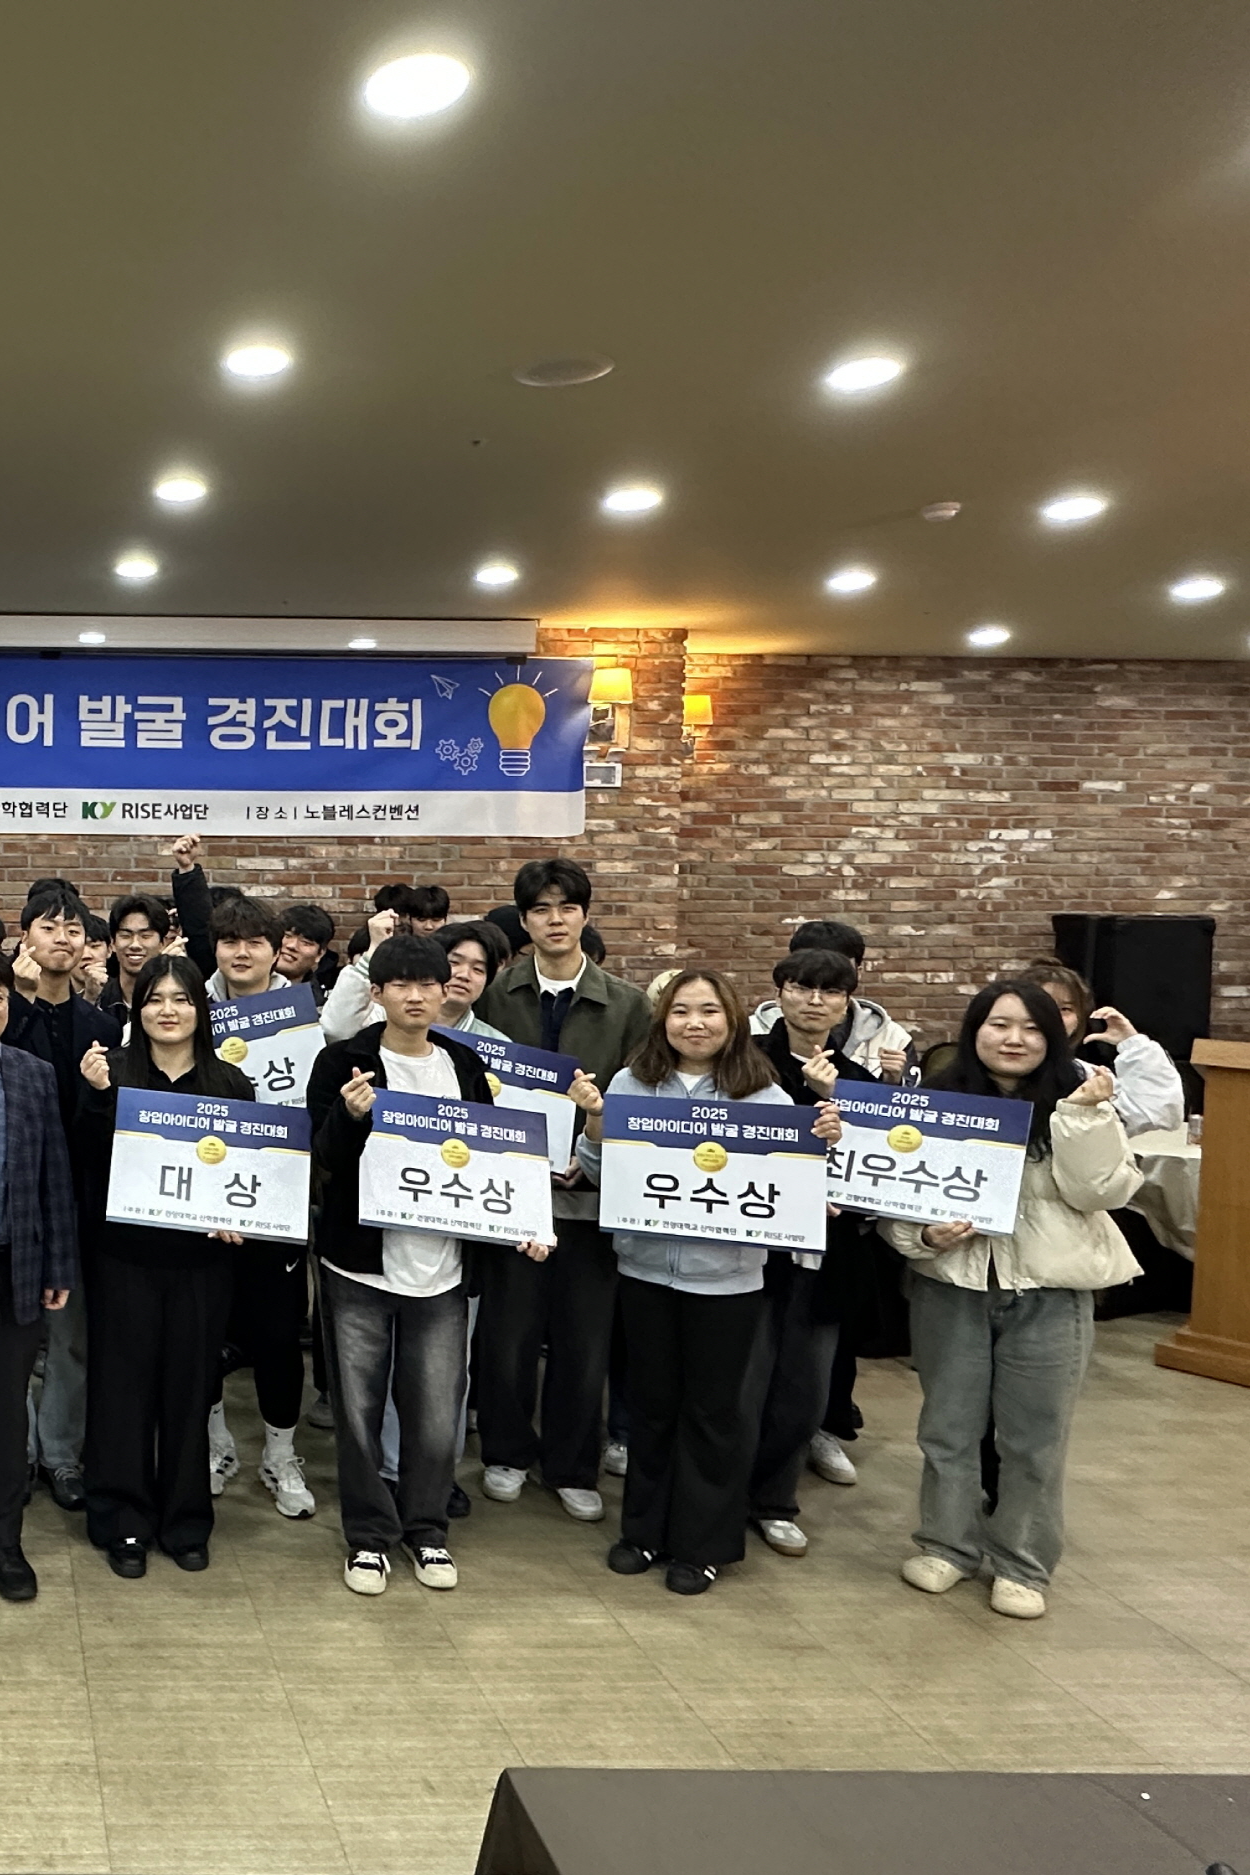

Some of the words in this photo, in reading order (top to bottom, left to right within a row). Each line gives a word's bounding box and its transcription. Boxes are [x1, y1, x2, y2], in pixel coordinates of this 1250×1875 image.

[78, 694, 187, 749] 발굴
[207, 697, 422, 751] 경진대회
[303, 804, 420, 821] 노블레스컨벤션
[209, 1005, 239, 1021] 2025
[251, 1005, 297, 1026] 경진대회
[476, 1040, 506, 1057] 2025
[514, 1062, 558, 1084] 경진대회
[196, 1102, 229, 1117] 2025
[891, 1091, 930, 1107] 2025
[437, 1103, 469, 1119] 2025
[691, 1106, 728, 1121] 2025
[909, 1108, 939, 1124] 발굴
[941, 1111, 1000, 1132] 경진대회
[138, 1109, 211, 1131] 창업아이디어
[213, 1118, 238, 1134] 발굴
[239, 1121, 288, 1139] 경진대회
[381, 1110, 452, 1133] 창업아이디어
[480, 1124, 527, 1144] 경진대회
[626, 1116, 708, 1136] 창업아이디어
[710, 1123, 739, 1138] 발굴
[741, 1125, 799, 1143] 경진대회
[398, 1167, 515, 1215] 우수상
[642, 1172, 781, 1219] 우수상
